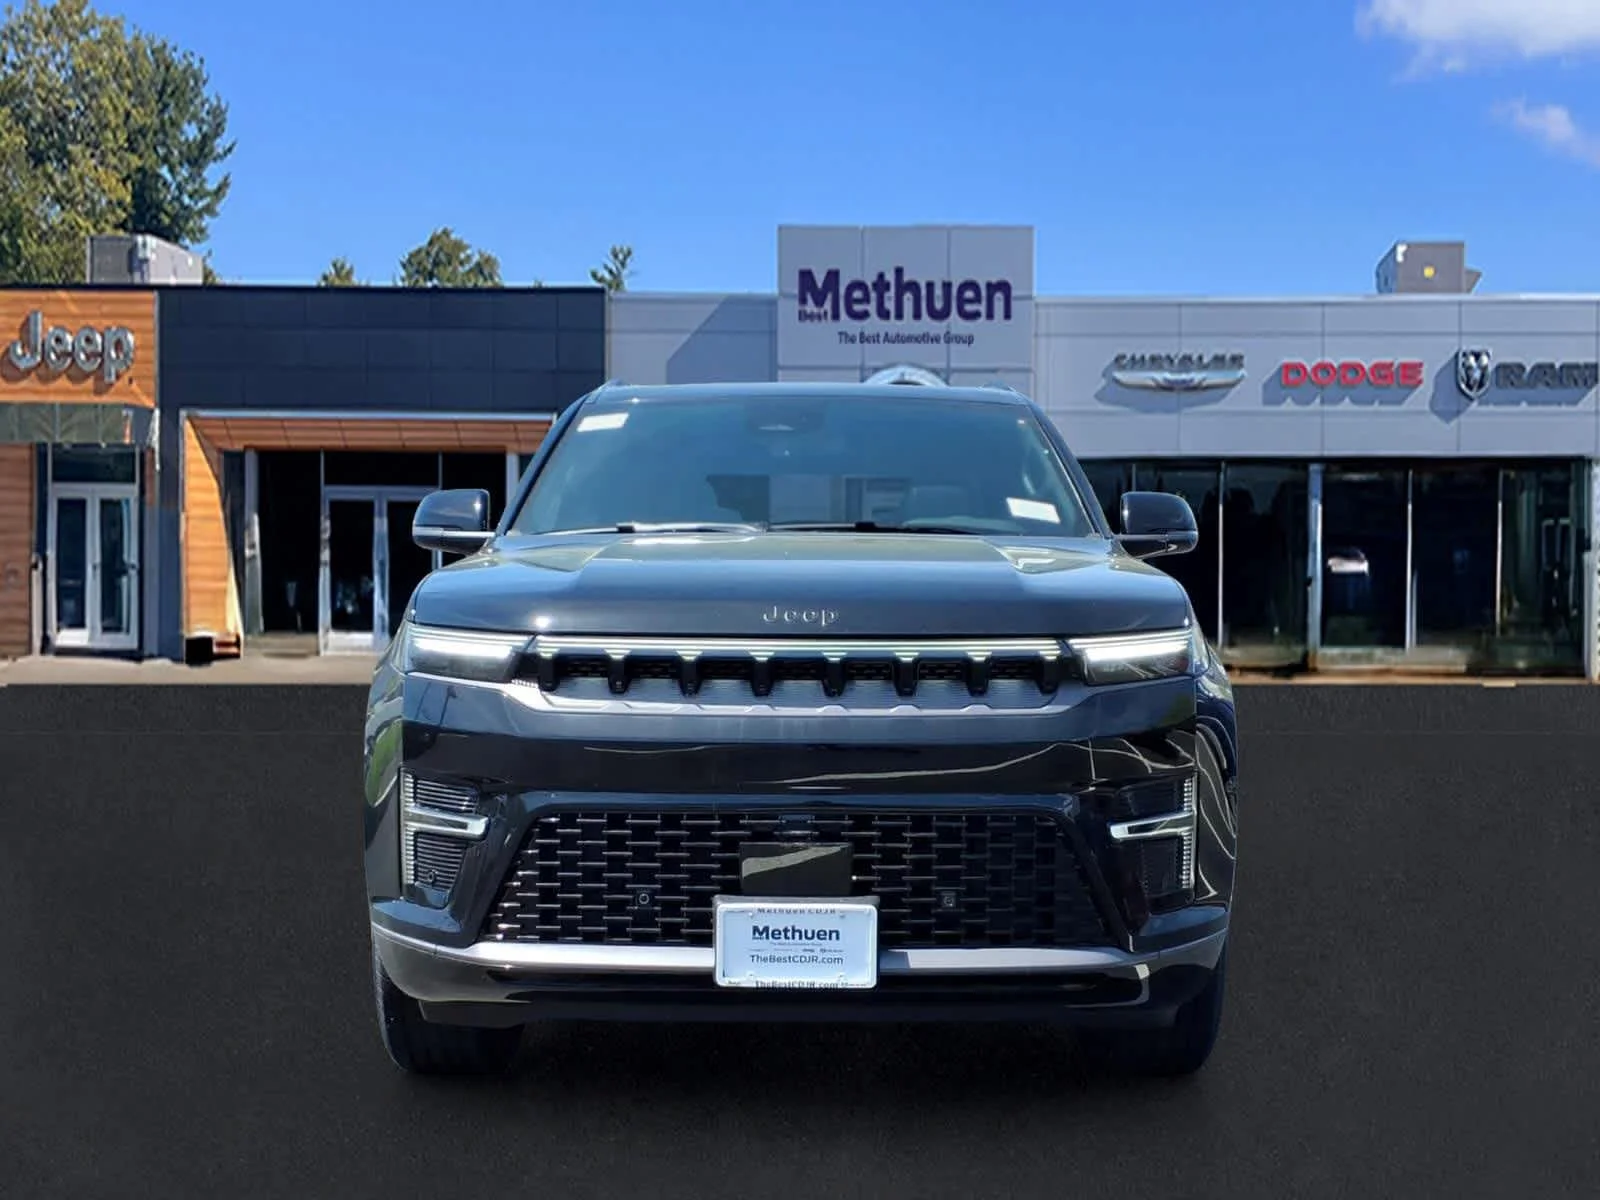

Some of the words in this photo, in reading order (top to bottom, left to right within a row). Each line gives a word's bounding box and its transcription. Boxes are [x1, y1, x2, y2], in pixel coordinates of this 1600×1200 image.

[798, 266, 1012, 322] Methuen
[9, 309, 135, 385] Jeep
[838, 331, 857, 345] The
[859, 331, 881, 345] Best
[883, 331, 941, 345] Automotive
[943, 331, 975, 347] Group
[1281, 361, 1424, 386] DODGE
[1495, 362, 1599, 388] RAM
[762, 605, 838, 627] Jeep
[752, 925, 840, 941] Methuen
[750, 954, 844, 965] TheBestCDJR.com
